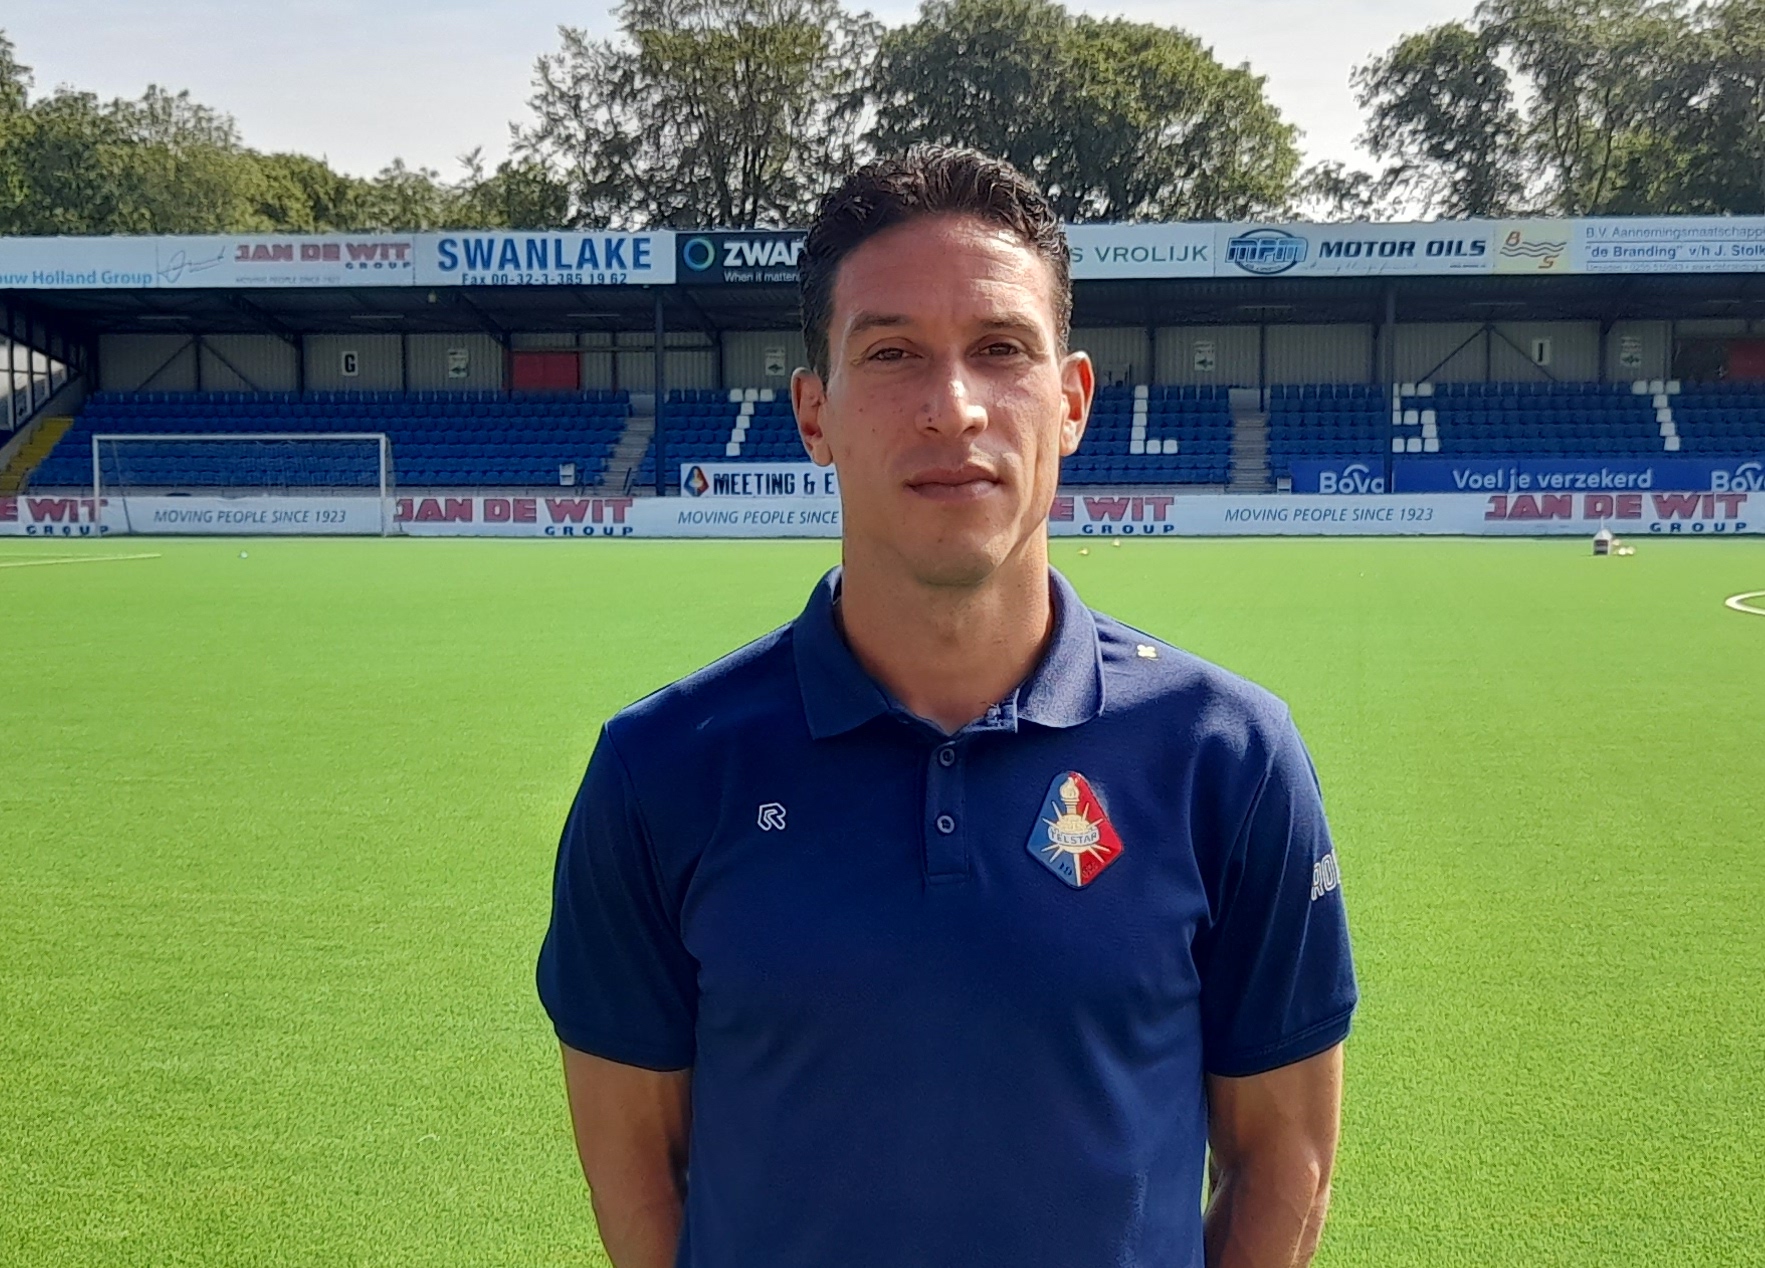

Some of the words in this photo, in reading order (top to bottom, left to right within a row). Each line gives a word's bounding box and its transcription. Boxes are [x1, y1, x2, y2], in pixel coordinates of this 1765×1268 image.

[235, 243, 293, 262] JAN
[300, 243, 340, 262] DE
[345, 243, 411, 261] WIT
[437, 237, 652, 272] SWANLAKE
[1094, 245, 1208, 263] VROLIJK
[1318, 239, 1415, 258] MOTOR
[1425, 239, 1486, 257] OILS
[345, 261, 411, 270] GROUP
[32, 270, 97, 285] Holland
[101, 270, 153, 288] Group
[462, 273, 486, 285] Fax
[491, 272, 583, 285] 00-32-3-385
[589, 272, 605, 285] 19
[610, 272, 628, 285] 62
[723, 271, 753, 282] When
[755, 271, 762, 282] it
[344, 353, 356, 373] G
[713, 472, 796, 496] MEETING
[803, 473, 816, 495] &
[1452, 467, 1503, 489] Voel
[1508, 467, 1531, 493] je
[1537, 467, 1653, 489] verzekerd
[26, 498, 109, 524] WIT
[393, 497, 474, 523] JAN
[482, 497, 538, 523] DE
[545, 497, 634, 524] WIT
[1083, 497, 1175, 522] WIT
[1225, 508, 1288, 522] MOVING
[1292, 508, 1348, 522] PEOPLE
[1352, 508, 1394, 522] SINCE
[1400, 508, 1434, 521] 1923
[1484, 494, 1573, 520] JAN
[1582, 494, 1643, 520] DE
[1651, 493, 1748, 520] WIT
[153, 509, 213, 524] MOVING
[217, 509, 268, 524] PEOPLE
[271, 509, 310, 524] SINCE
[315, 509, 347, 524] 1923
[677, 510, 739, 525] MOVING
[742, 510, 796, 525] PEOPLE
[799, 510, 840, 525] SINCE
[544, 525, 634, 536] GROUP
[1082, 523, 1175, 535] GROUP
[1650, 522, 1748, 533] GROUP
[1050, 831, 1098, 845] TELSTAR
[1311, 848, 1341, 902] RO
